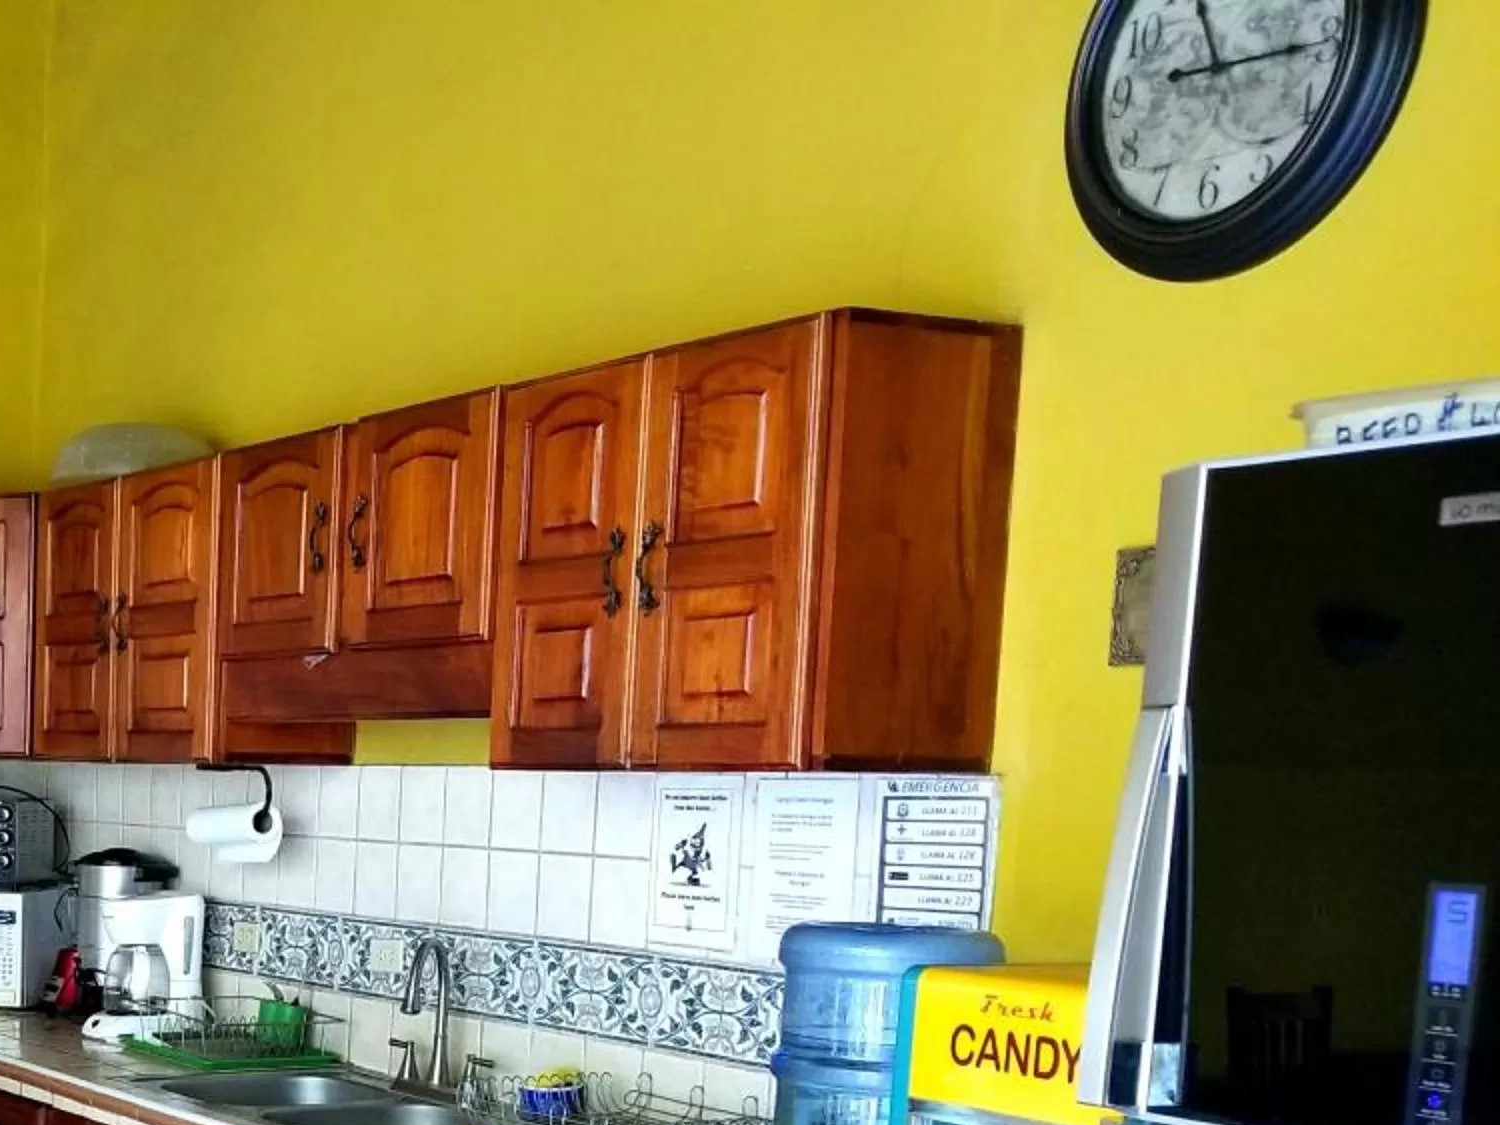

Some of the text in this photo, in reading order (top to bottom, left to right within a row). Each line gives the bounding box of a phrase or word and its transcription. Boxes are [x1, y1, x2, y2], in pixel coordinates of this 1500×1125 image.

[1129, 12, 1161, 59] 10
[1111, 75, 1132, 119] 9
[1119, 128, 1138, 169] 8
[1152, 162, 1174, 207] 7
[1198, 163, 1220, 210] 6
[980, 993, 1056, 1023] Fresh
[950, 1023, 1083, 1085] CANDY
